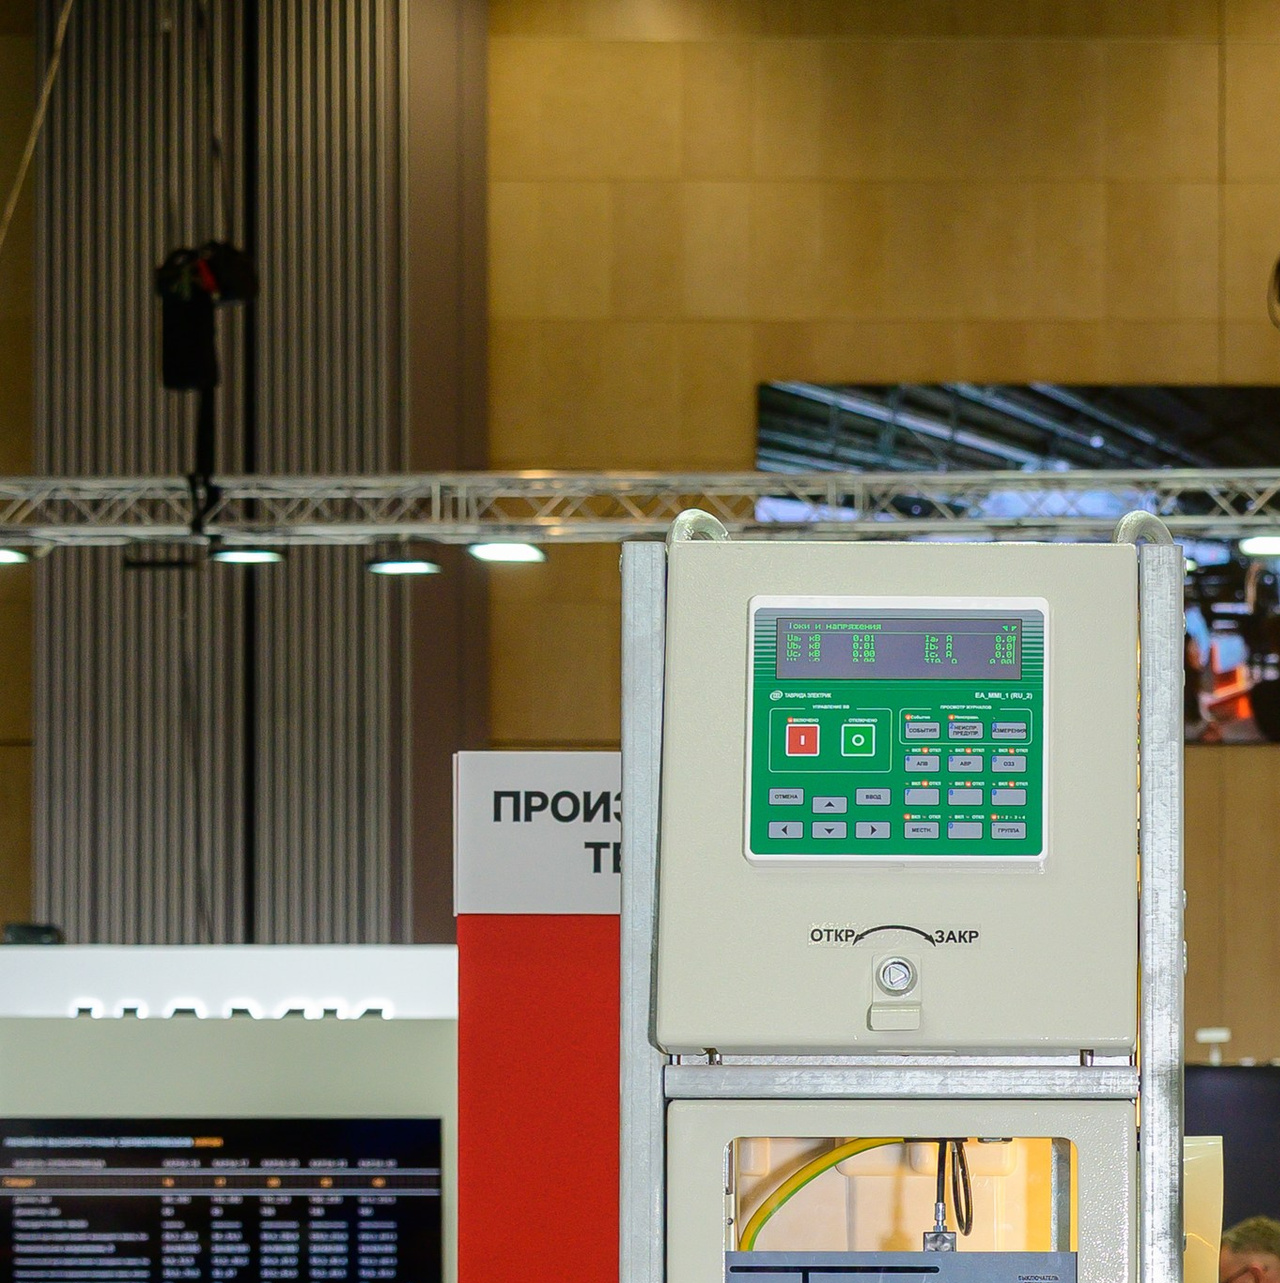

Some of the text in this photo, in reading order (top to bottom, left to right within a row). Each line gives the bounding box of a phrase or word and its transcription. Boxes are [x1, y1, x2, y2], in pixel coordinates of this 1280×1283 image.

[975, 692, 1033, 700] EA_MMI_1 (RU_2)
[810, 928, 855, 942] ОТКР
[935, 930, 979, 943] ЗАКР
